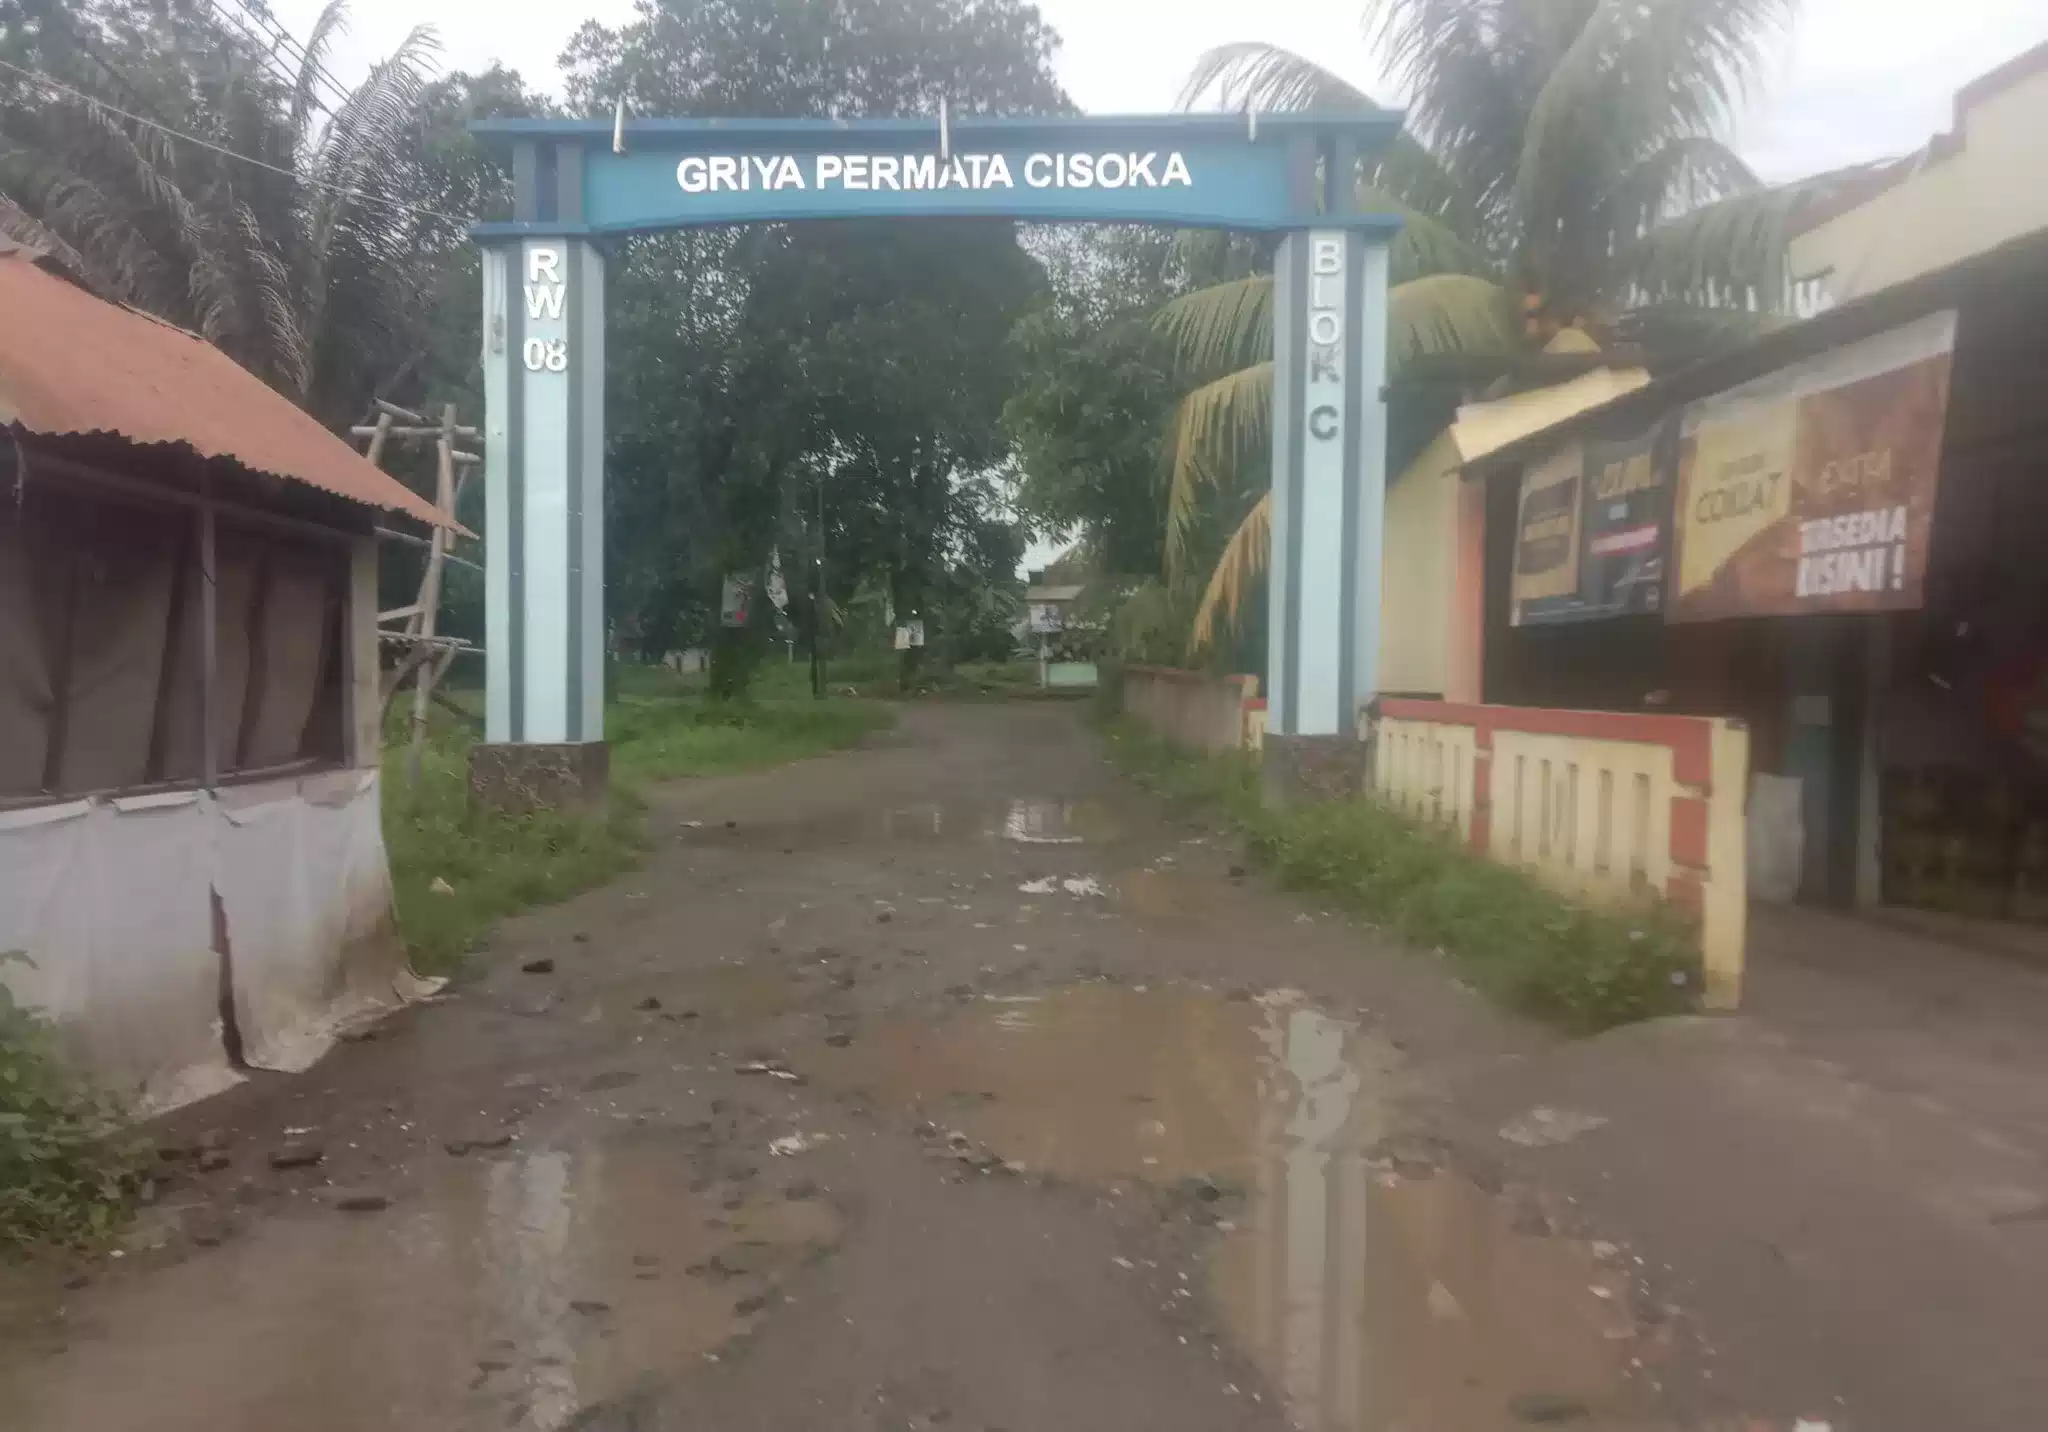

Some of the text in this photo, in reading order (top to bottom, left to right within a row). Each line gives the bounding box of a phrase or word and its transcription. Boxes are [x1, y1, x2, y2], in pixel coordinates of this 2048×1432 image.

[676, 151, 1193, 192] GRIYA PERMATA CISOKA
[522, 248, 568, 372] RW 08
[1308, 239, 1343, 441] BLOK C
